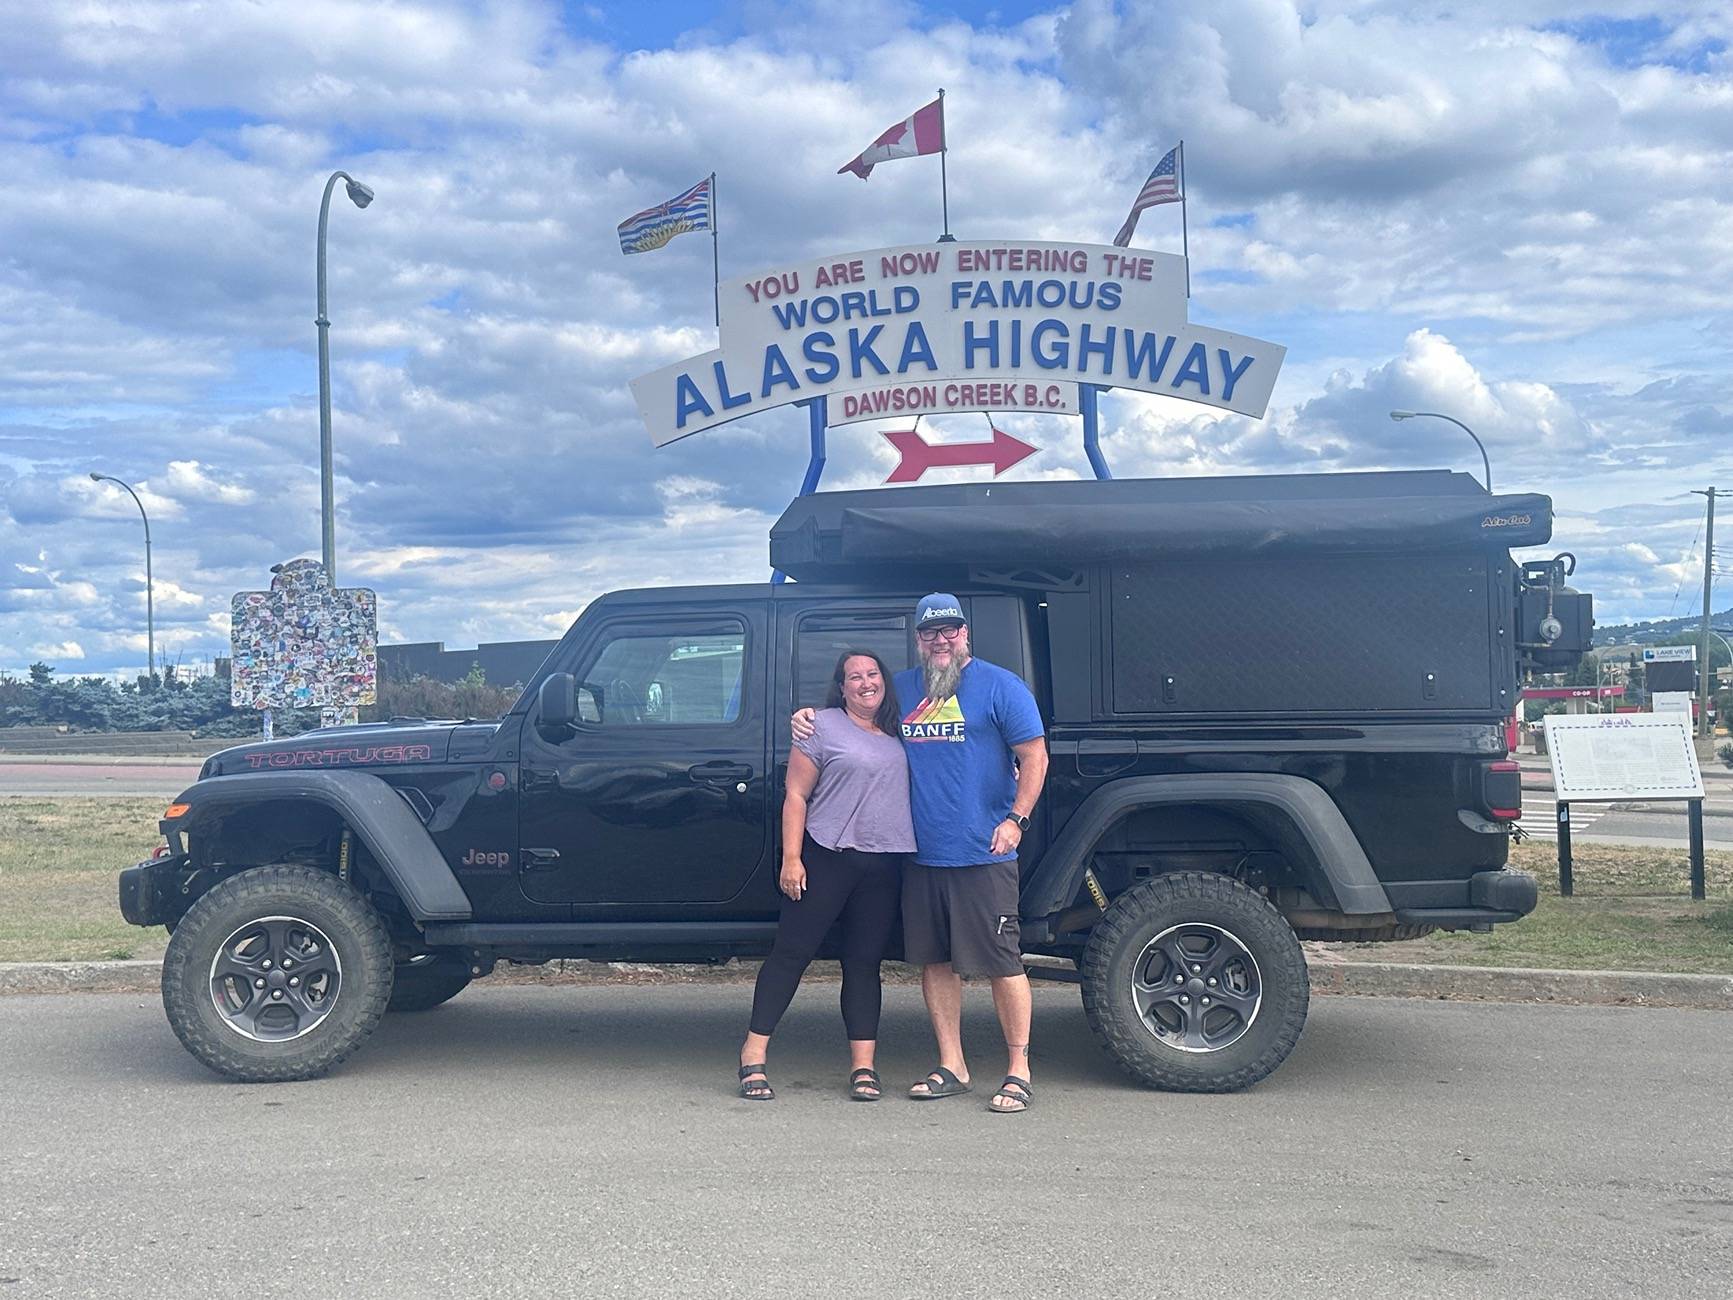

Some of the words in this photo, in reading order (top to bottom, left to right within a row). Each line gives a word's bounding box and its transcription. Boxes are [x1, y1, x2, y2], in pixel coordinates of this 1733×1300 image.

[745, 271, 800, 303] YOU
[814, 261, 865, 289] ARE
[880, 251, 941, 278] NOW
[958, 248, 1088, 273] ENTERING
[1103, 254, 1154, 281] THE
[772, 286, 920, 330] WORLD
[951, 280, 1123, 310] FAMOUS
[675, 321, 938, 429] ALASKA
[965, 319, 1255, 401] HIGHWAY
[843, 385, 937, 418] DAWSON
[944, 382, 1018, 407] CREEK
[1024, 384, 1067, 410] B.C.
[901, 723, 965, 737] BANFF
[948, 735, 965, 743] 1885
[245, 745, 431, 768] TORTUGA
[462, 849, 510, 868] Jeep
